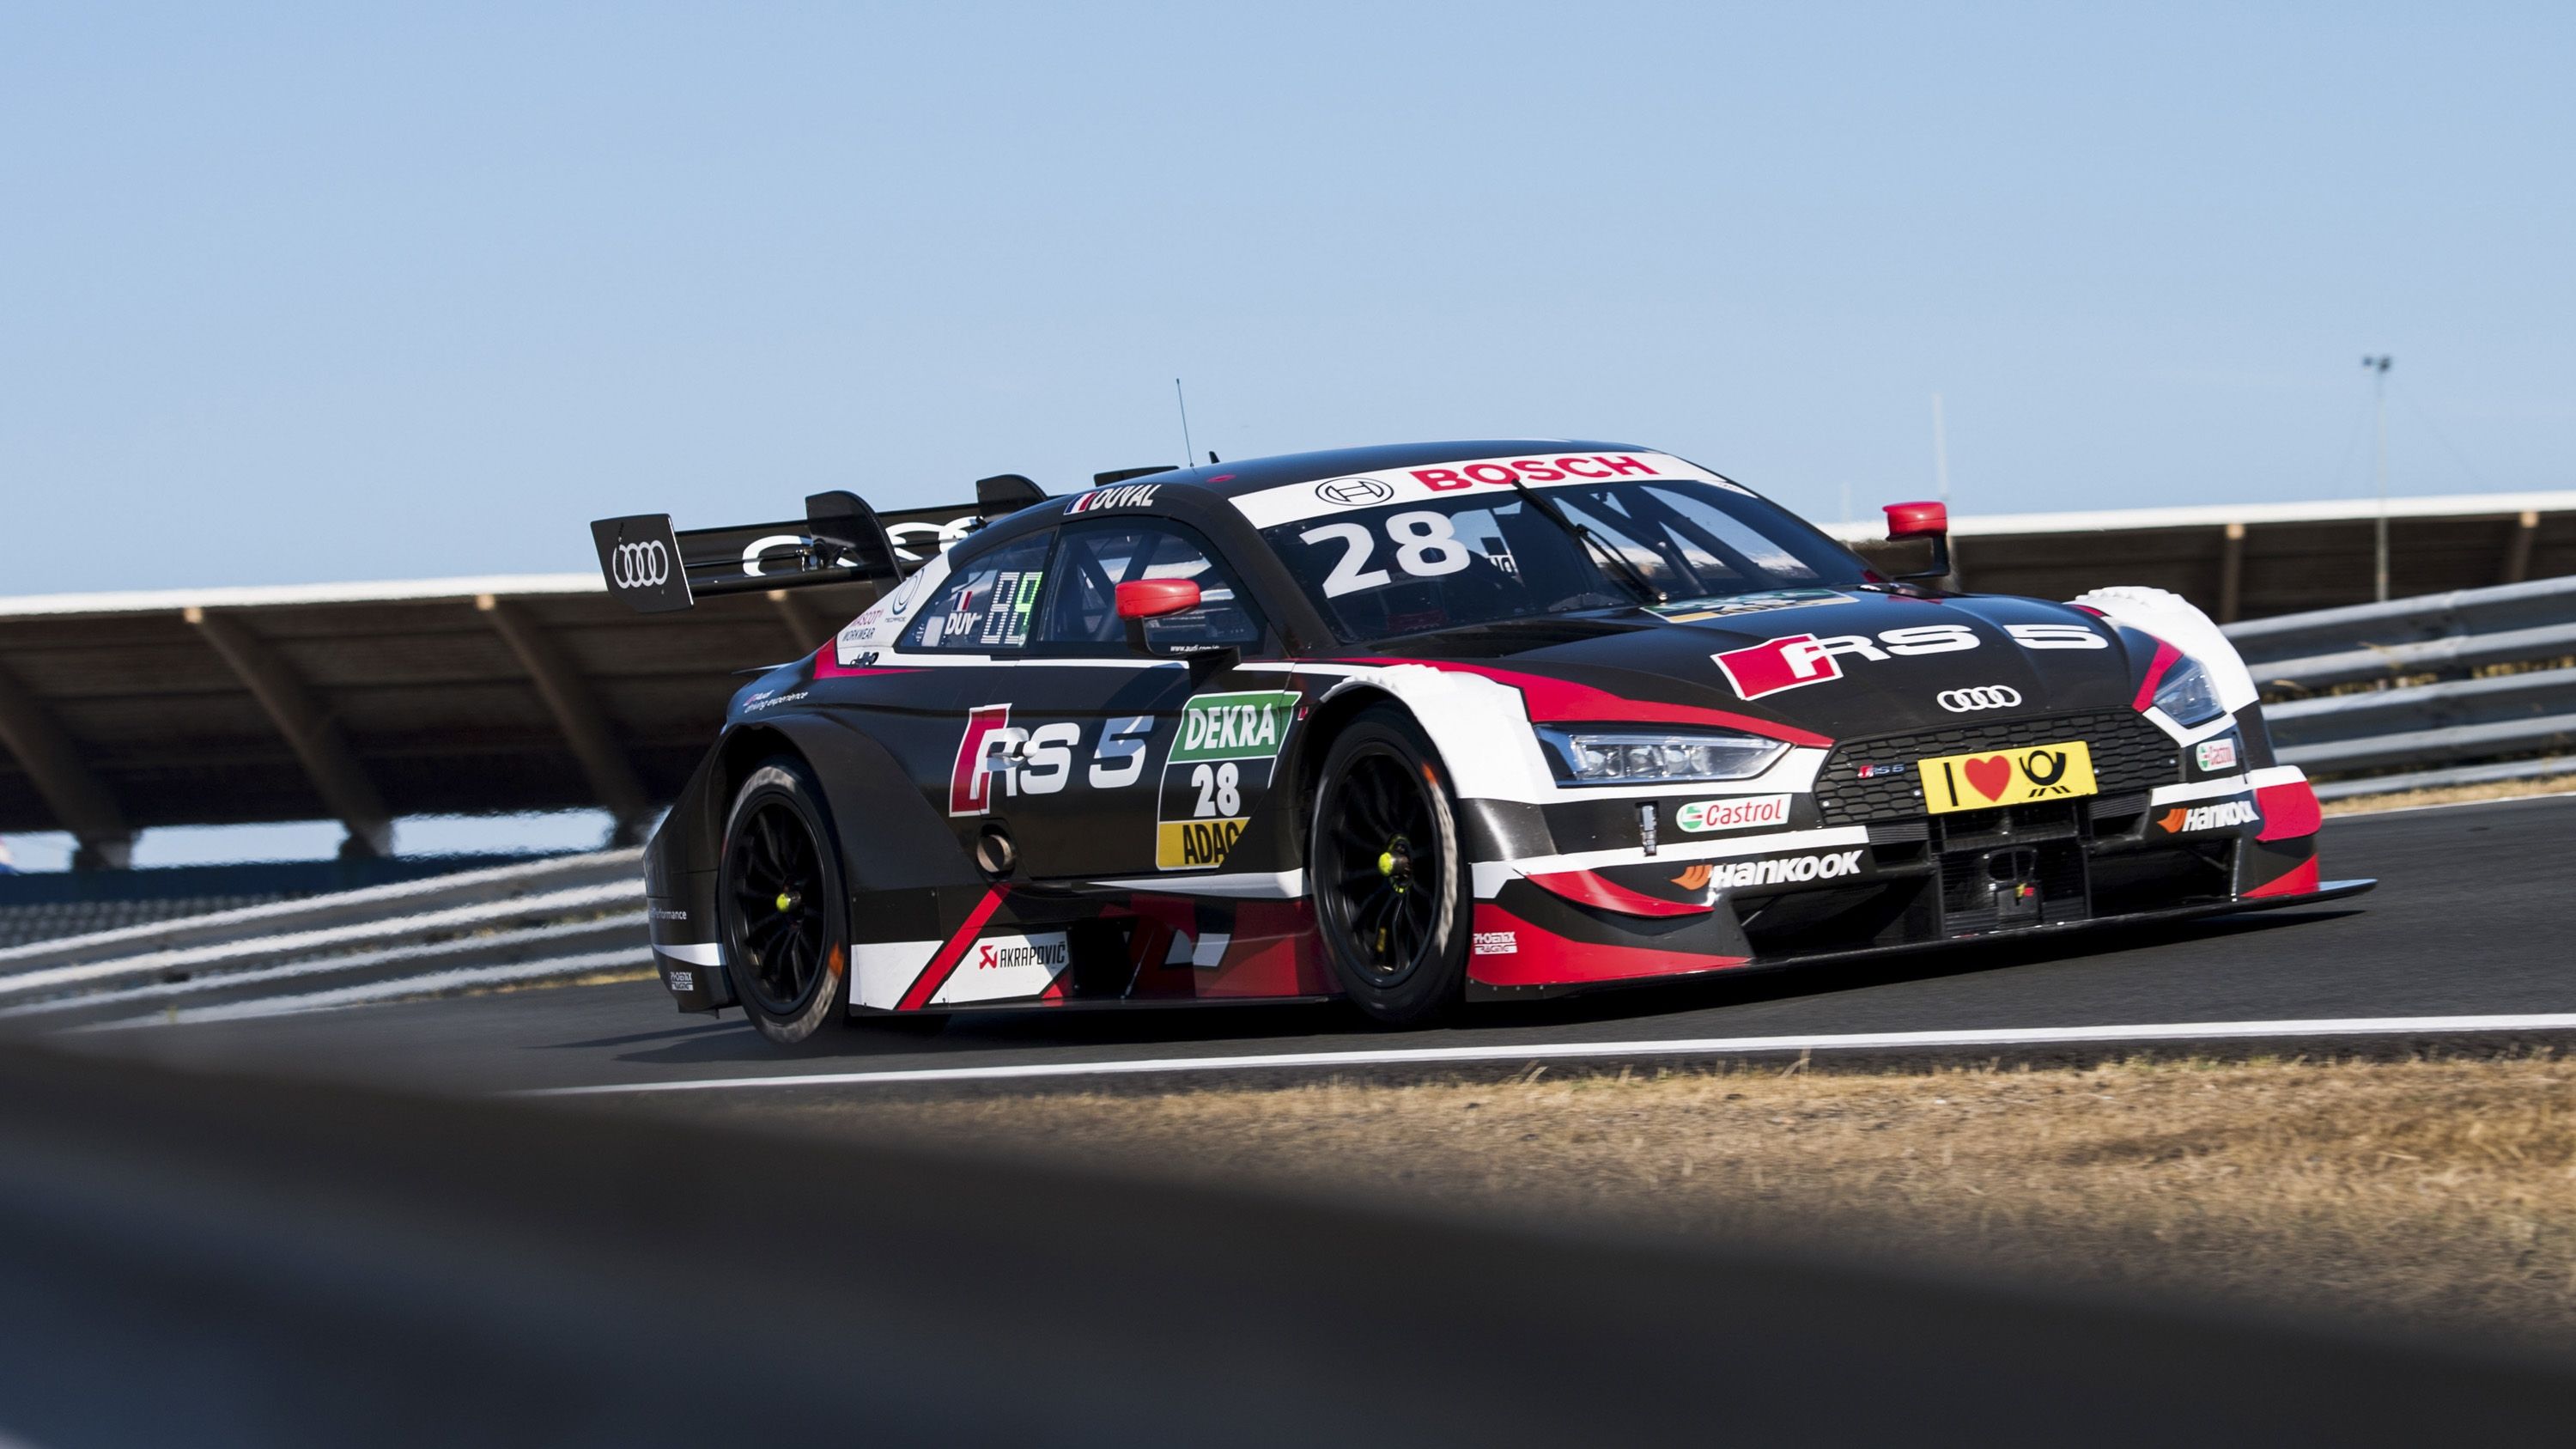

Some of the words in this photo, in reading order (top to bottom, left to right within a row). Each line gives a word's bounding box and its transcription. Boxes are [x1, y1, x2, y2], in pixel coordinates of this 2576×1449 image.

[1089, 484, 1162, 511] DUVAL
[1409, 455, 1660, 492] BOSCH
[1299, 510, 1471, 599] 28
[1776, 624, 1981, 681] RS
[2002, 624, 2109, 649] 5
[1183, 702, 1276, 752] DEKRA
[965, 718, 1081, 801] RS
[1088, 715, 1155, 789] 5
[1193, 762, 1241, 817] 28
[1706, 798, 1783, 826] Castrol
